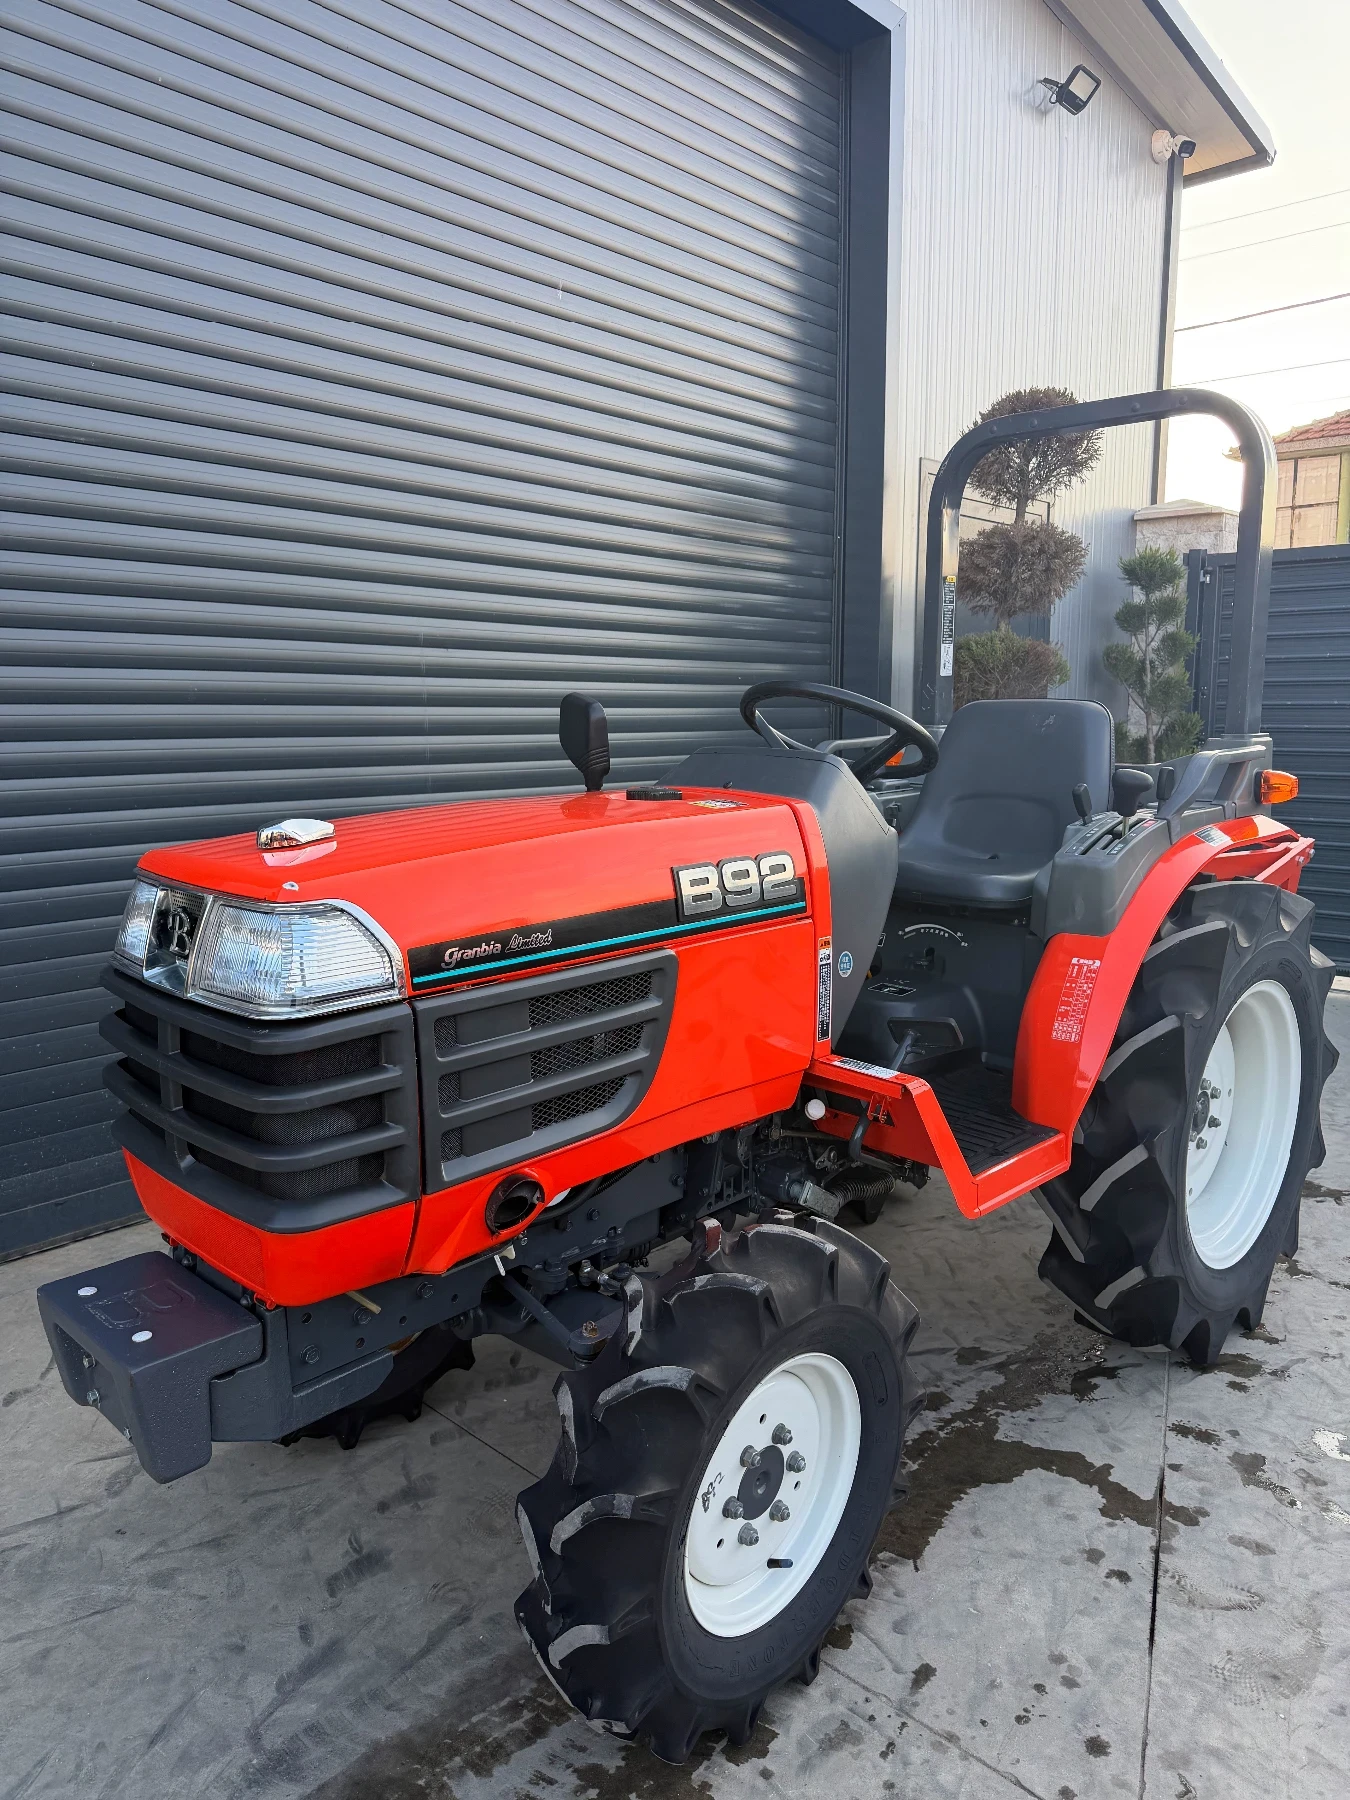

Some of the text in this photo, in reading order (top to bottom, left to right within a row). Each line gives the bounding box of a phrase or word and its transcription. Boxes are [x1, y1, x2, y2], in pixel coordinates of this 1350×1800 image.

[677, 853, 799, 917] B92
[441, 928, 553, 969] Granbia Limited
